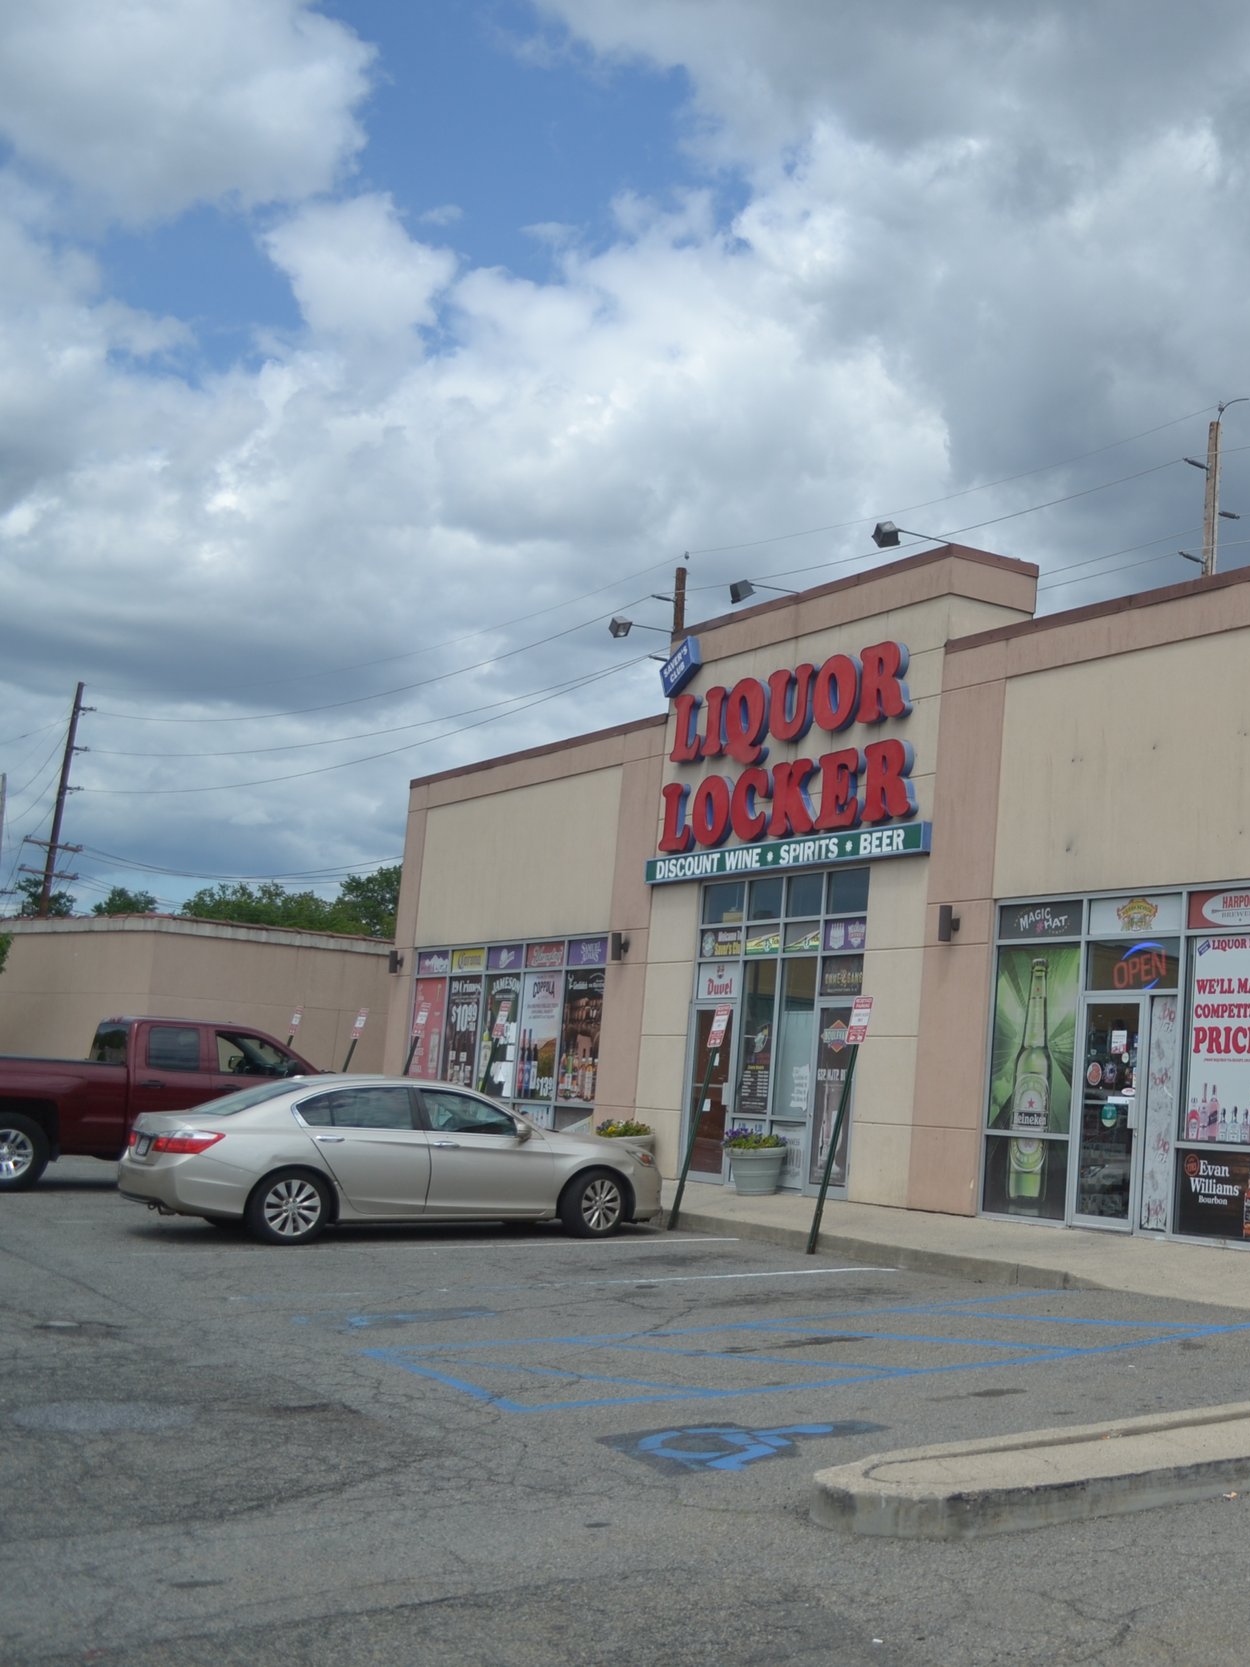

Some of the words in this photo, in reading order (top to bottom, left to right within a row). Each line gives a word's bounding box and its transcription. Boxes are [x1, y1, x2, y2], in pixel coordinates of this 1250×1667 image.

[663, 645, 688, 678] SAVER'S
[669, 661, 685, 683] CLUB
[669, 640, 909, 765] LIQUOR
[658, 738, 915, 852] LOCKER
[655, 853, 720, 880] DISCOUNT
[725, 848, 762, 870] WINE
[779, 837, 839, 864] SPIRITS
[859, 829, 905, 855] BEER
[1019, 907, 1051, 932] MAGIC
[1044, 915, 1068, 929] HAT
[1212, 938, 1247, 951] LIQUOR
[1113, 950, 1167, 988] OPEN
[491, 976, 520, 995] JAMESON
[532, 980, 555, 998] COPPOLA
[707, 978, 733, 996] Duvel
[1196, 977, 1235, 995] WE'LL
[1013, 1112, 1047, 1126] Heineken
[1198, 1159, 1230, 1177] Evan
[1189, 1176, 1240, 1197] Williams
[1198, 1194, 1228, 1206] Bourbon
